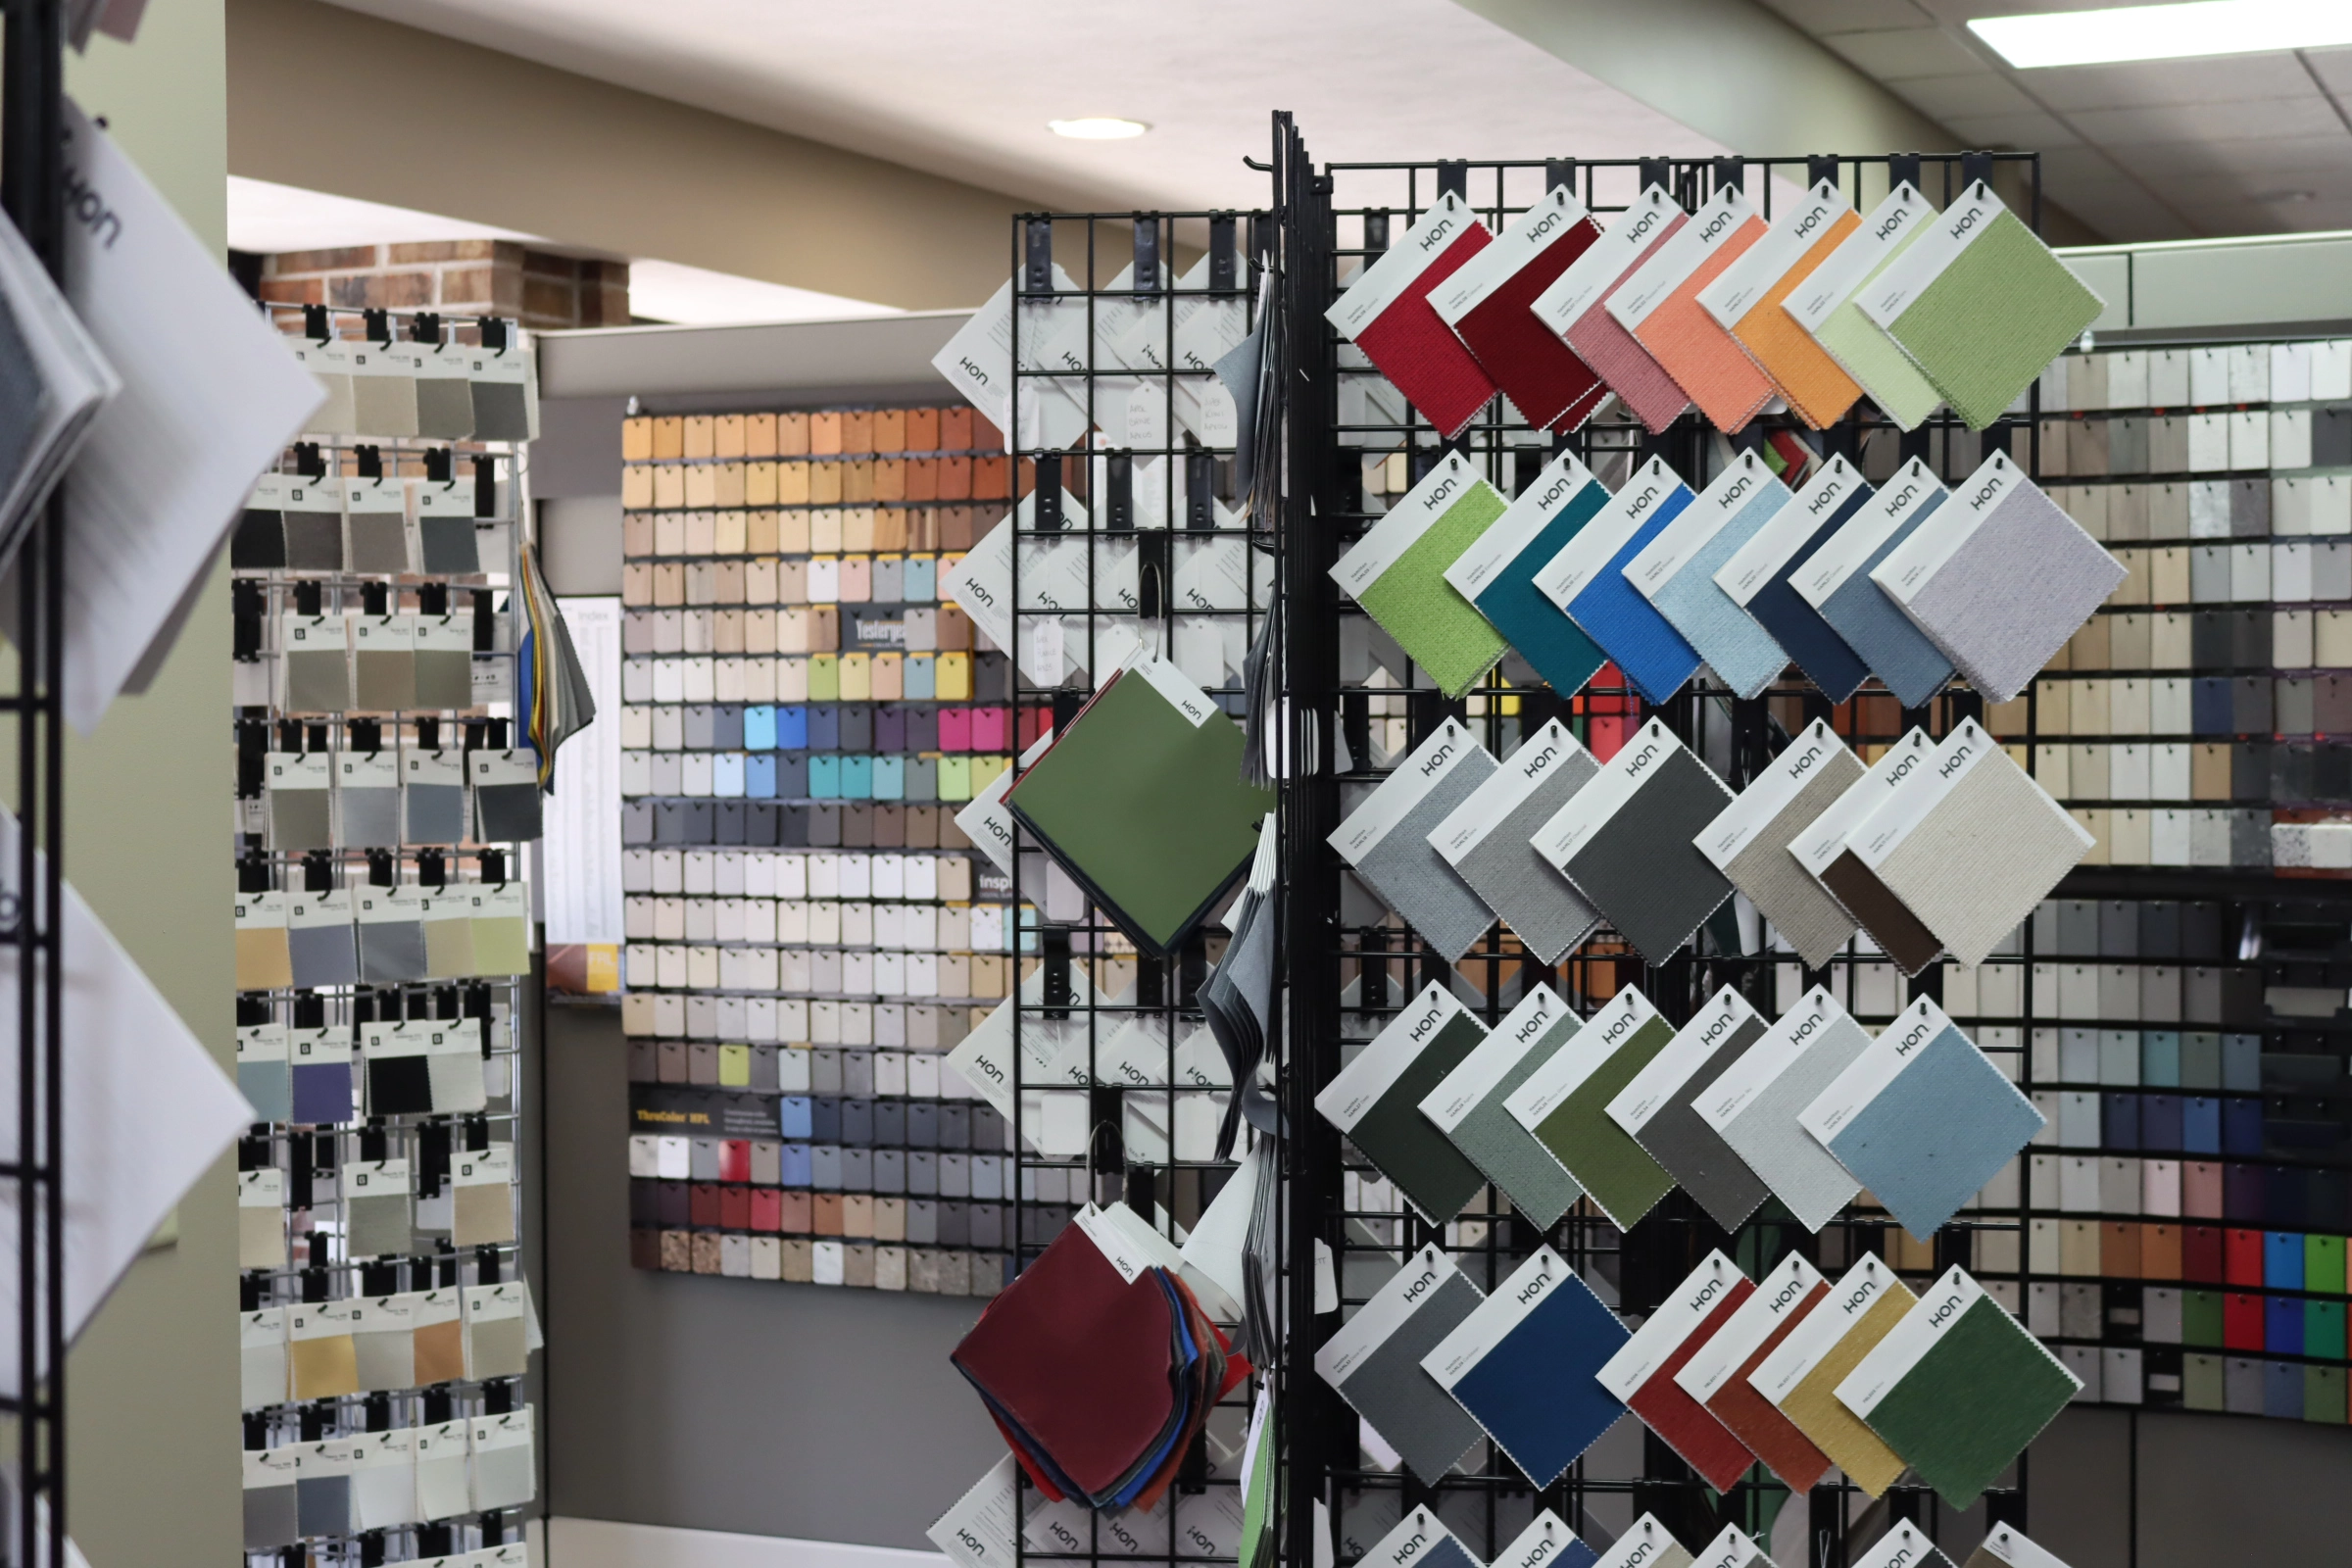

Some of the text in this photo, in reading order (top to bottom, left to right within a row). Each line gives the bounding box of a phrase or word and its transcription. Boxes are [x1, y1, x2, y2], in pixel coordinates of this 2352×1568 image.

[1419, 219, 1453, 252] HON
[1526, 212, 1562, 243] HON
[1626, 211, 1659, 244] HON
[1699, 211, 1733, 243] HON
[1793, 206, 1828, 239] HON
[1876, 208, 1908, 241] HON
[1950, 207, 1983, 240] HON
[959, 357, 989, 385] HON
[1423, 478, 1457, 511] HON
[1537, 477, 1571, 511] HON
[1626, 486, 1659, 519] HON
[1718, 476, 1752, 510] HON
[1808, 481, 1841, 515] HON
[1885, 484, 1919, 517] HON
[1970, 477, 2003, 511] HON
[965, 577, 994, 608] HON
[1118, 588, 1138, 610] HO
[1181, 700, 1201, 720] HON
[1420, 744, 1454, 777] HON
[1523, 746, 1557, 779] HON
[1625, 744, 1659, 777] HON
[1788, 746, 1822, 779] HON
[1886, 754, 1919, 787] HON
[1938, 746, 1972, 779] HON
[983, 816, 1012, 846] HON
[1409, 1008, 1443, 1043] HON
[1515, 1010, 1549, 1044] HON
[1601, 1012, 1637, 1045] HON
[1700, 1013, 1736, 1047] HON
[1788, 1013, 1824, 1046] HON
[1895, 1023, 1930, 1056] HON
[974, 1054, 1004, 1084] HON
[1068, 1066, 1089, 1086] HO
[1115, 1256, 1134, 1277] HON
[1402, 1271, 1437, 1303] HON
[1516, 1272, 1552, 1305] HON
[1690, 1278, 1724, 1312] HON
[1769, 1280, 1804, 1314] HON
[1842, 1281, 1878, 1314] HON
[1928, 1295, 1963, 1328] HON
[956, 1528, 986, 1556] HON
[1050, 1521, 1079, 1550] HON
[1109, 1523, 1139, 1552] HON
[1187, 1526, 1216, 1555] HON
[1344, 1537, 1367, 1558] HO
[1392, 1533, 1427, 1565] HON
[1521, 1539, 1555, 1568] HON
[1714, 1554, 1738, 1568] ON
[1885, 1548, 1912, 1568] ON
